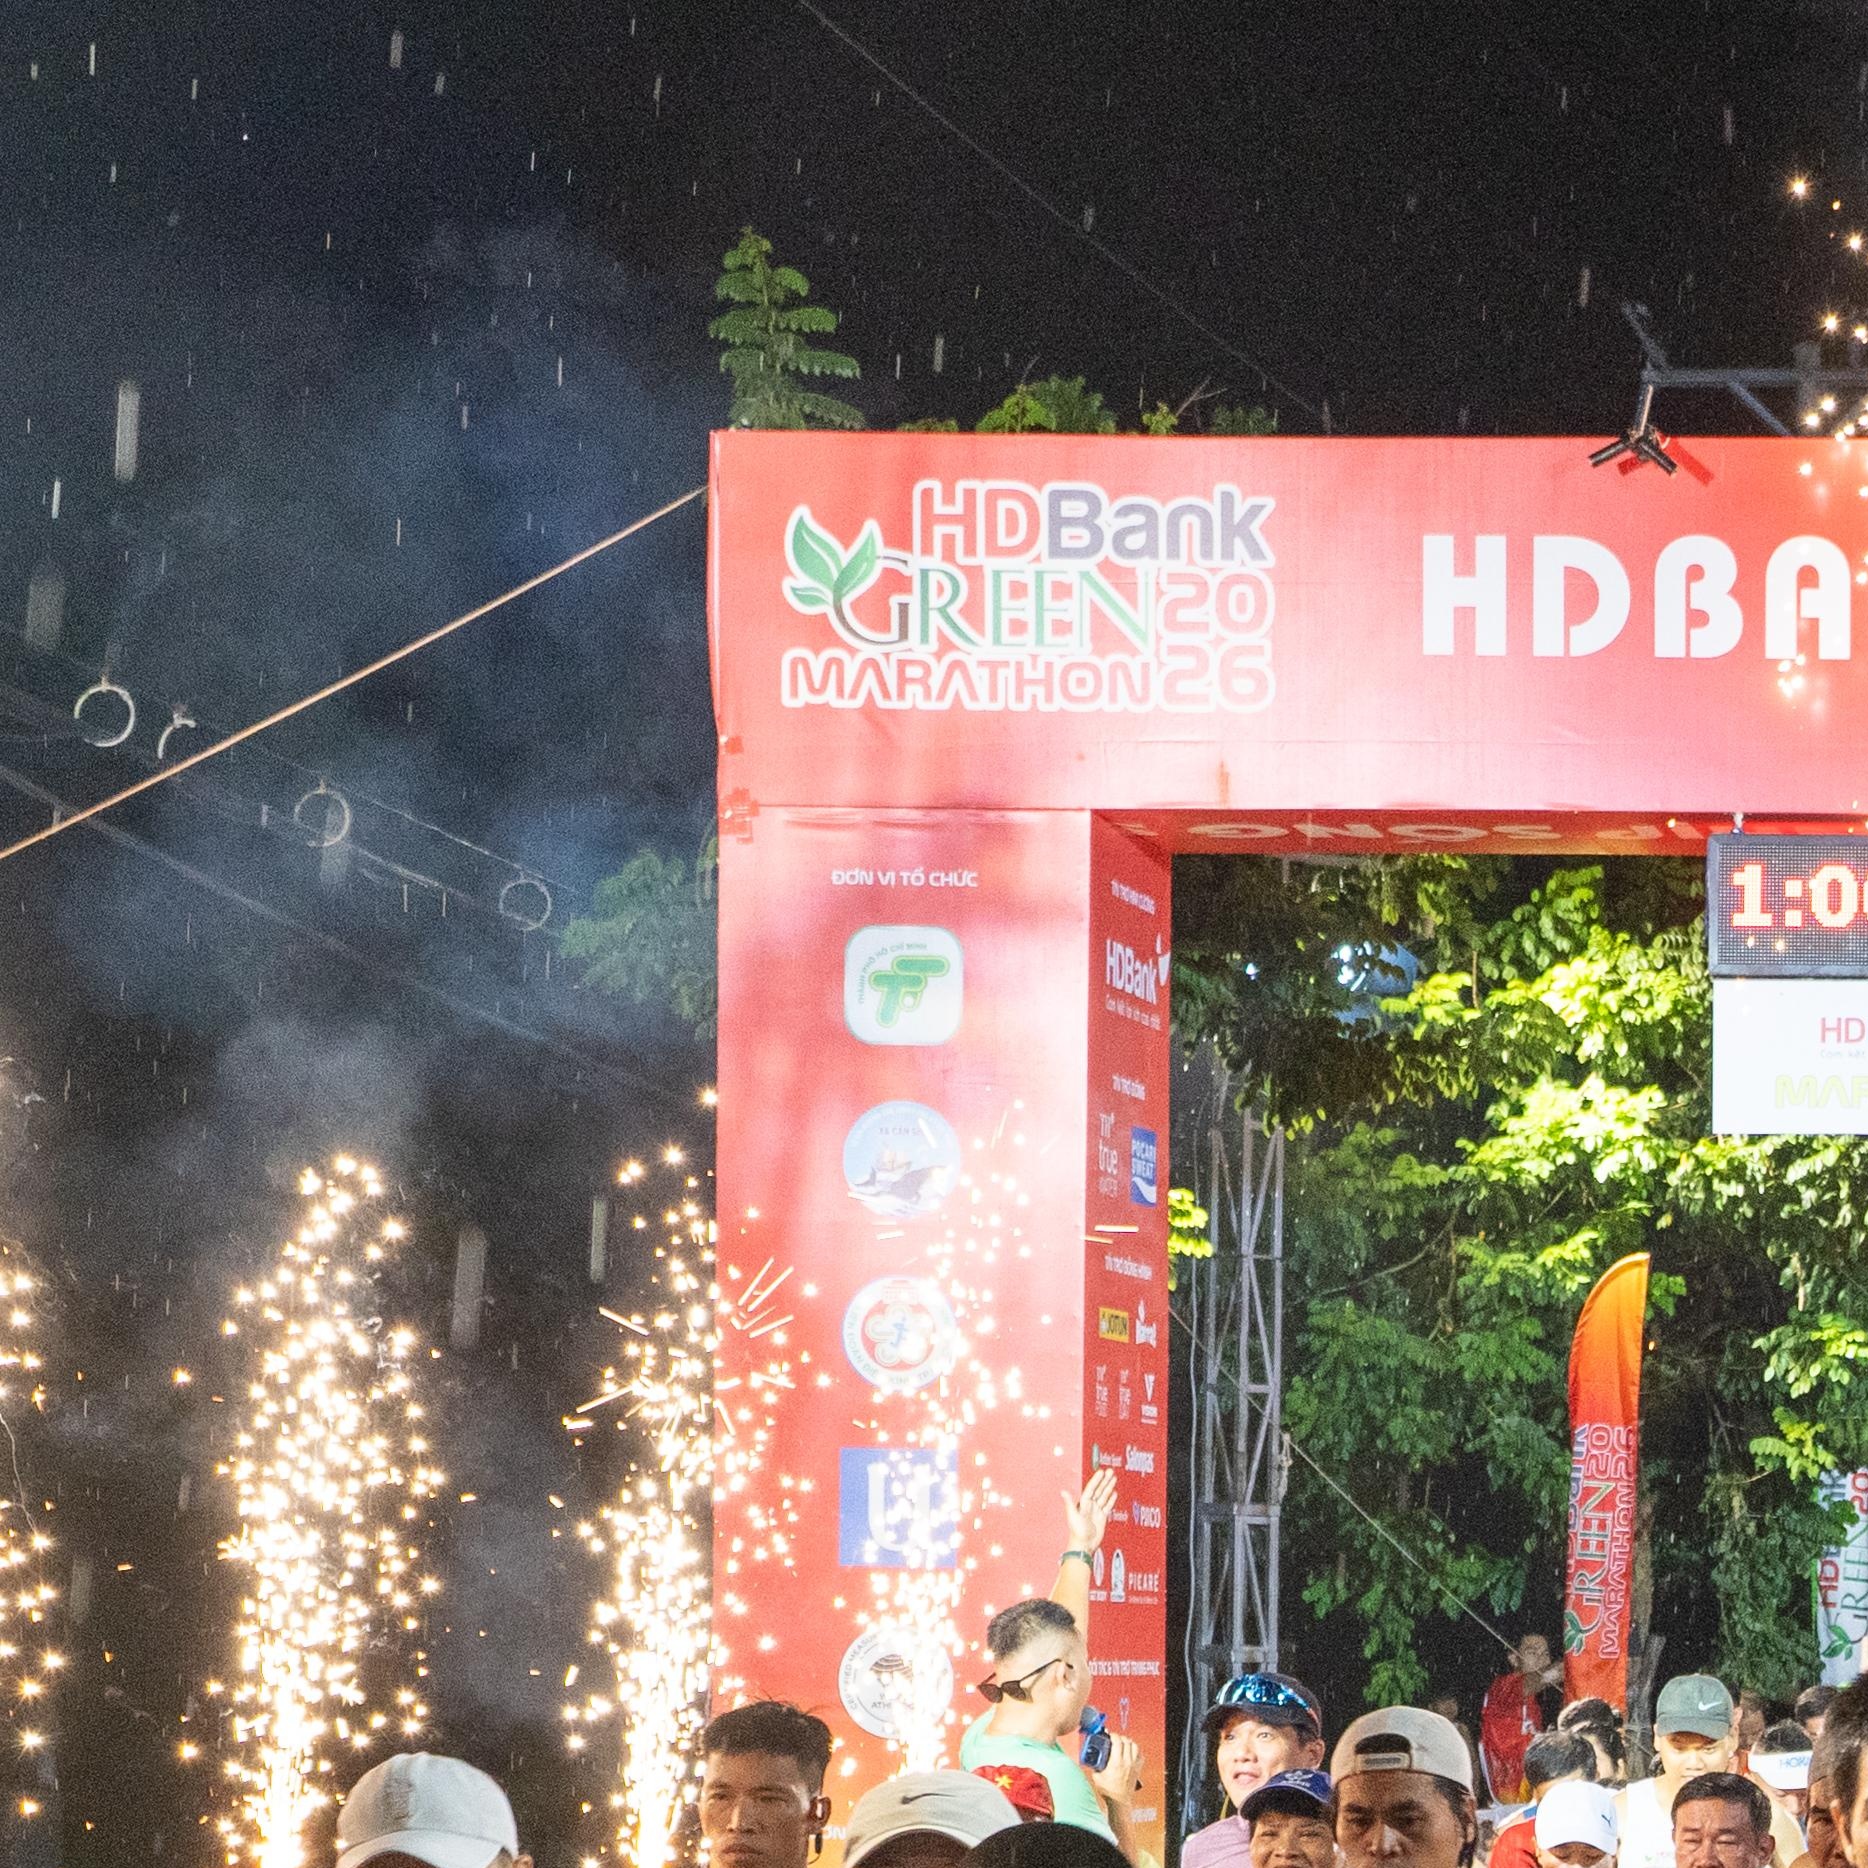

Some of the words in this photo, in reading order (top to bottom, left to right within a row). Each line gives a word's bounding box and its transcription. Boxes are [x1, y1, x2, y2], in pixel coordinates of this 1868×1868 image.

[917, 482, 1273, 565] HDBank
[834, 554, 1154, 648] GREEN
[1160, 566, 1271, 640] 20
[786, 655, 1152, 706] MARATHON
[1160, 641, 1271, 709] 26
